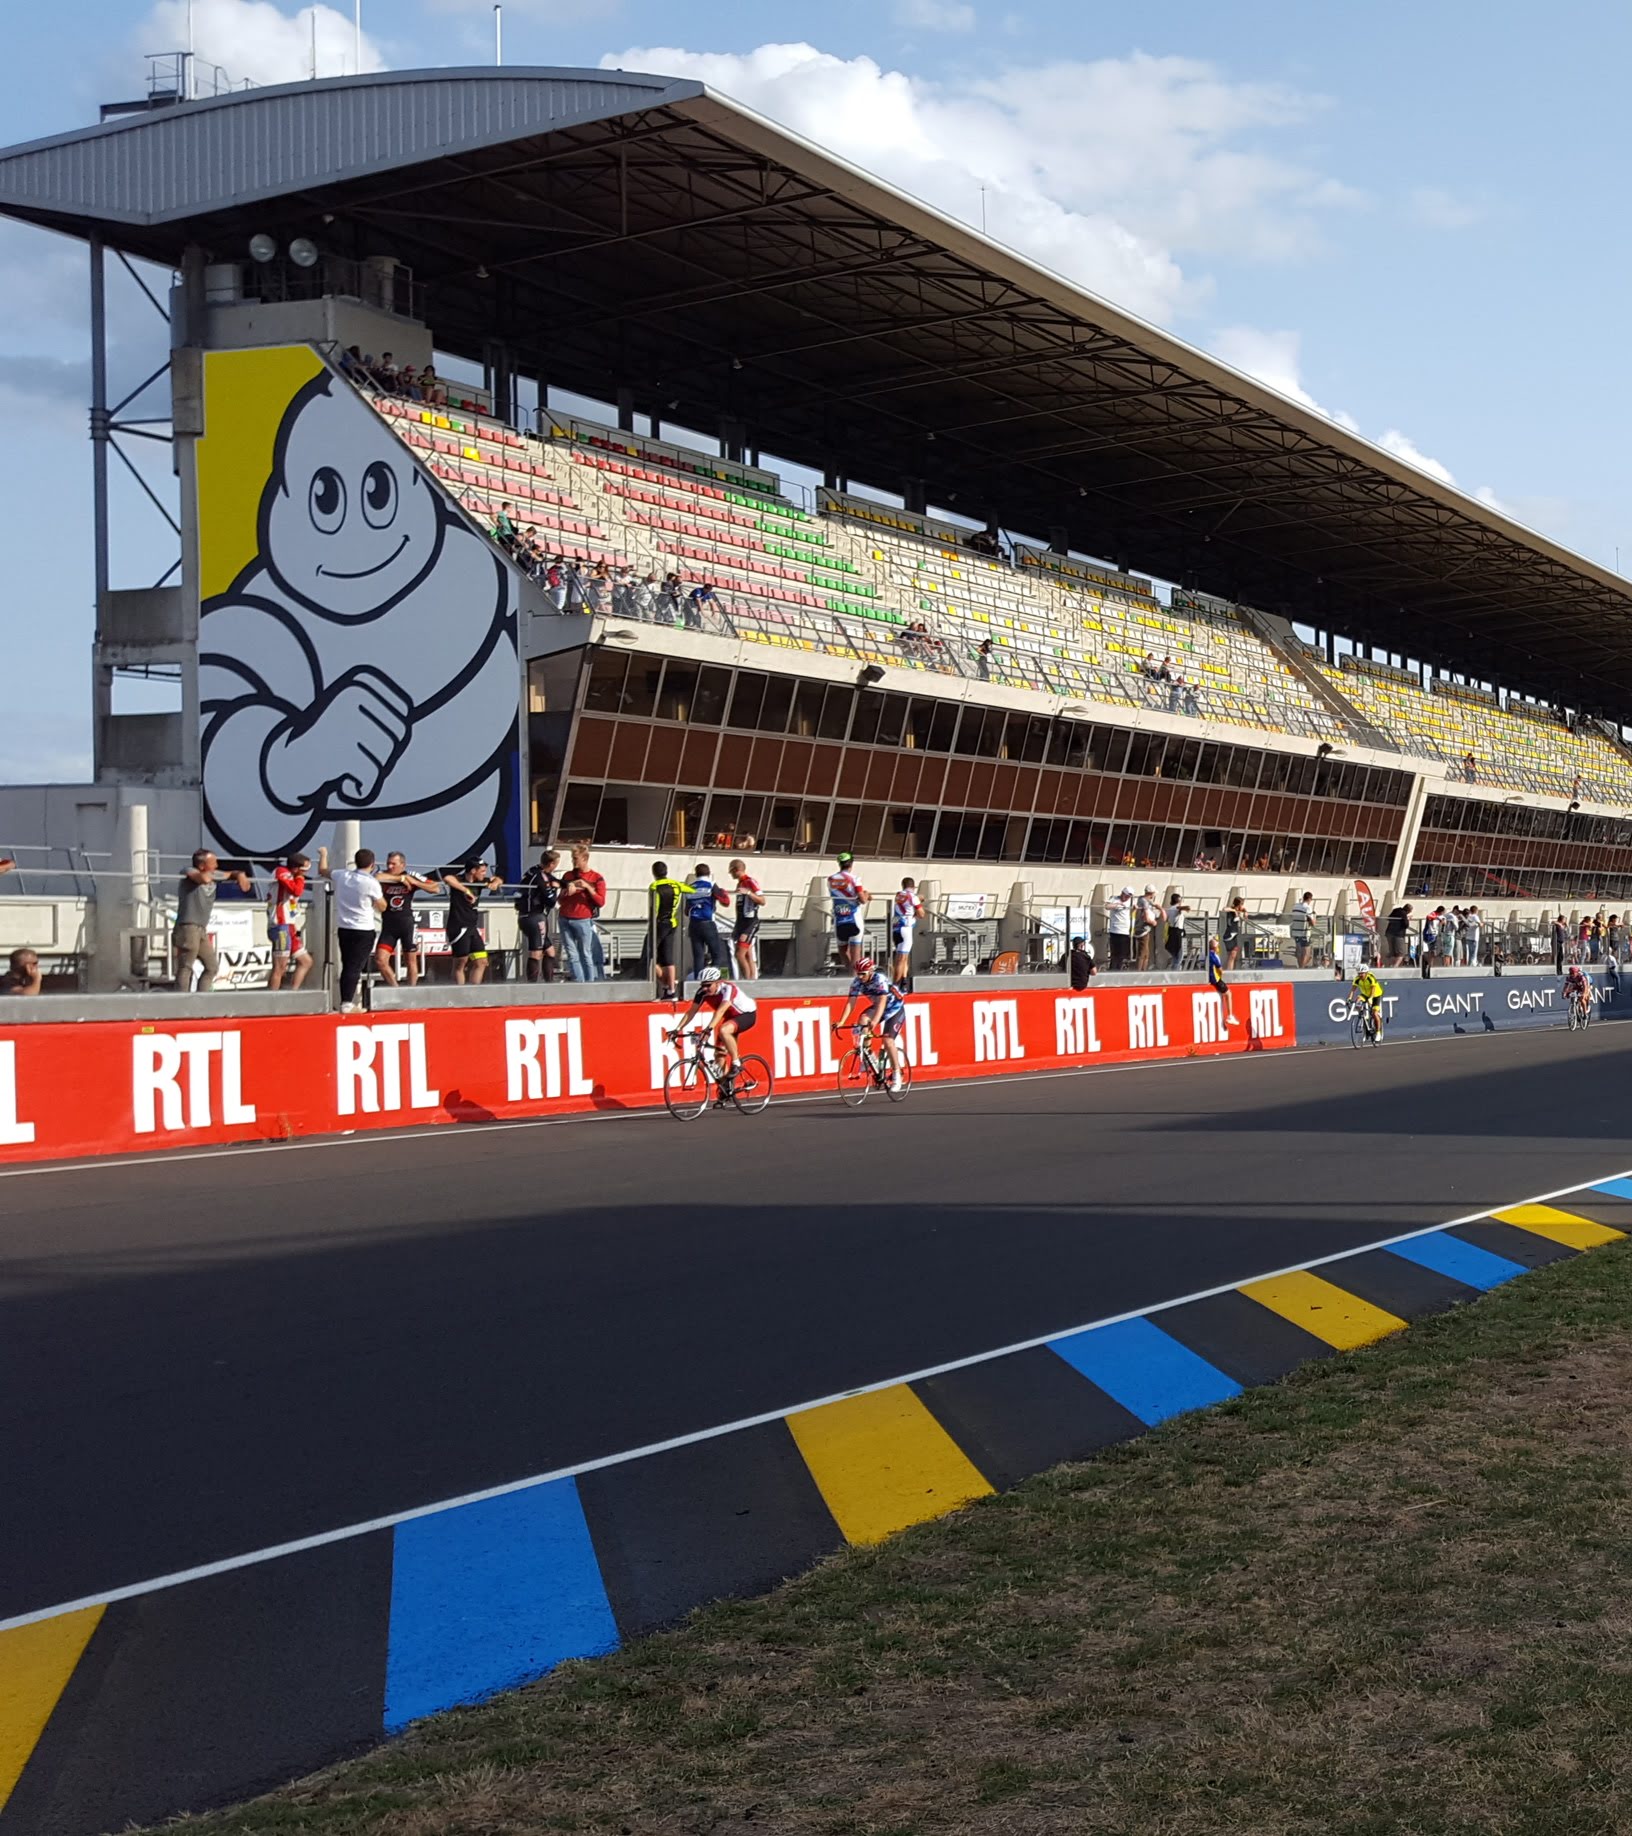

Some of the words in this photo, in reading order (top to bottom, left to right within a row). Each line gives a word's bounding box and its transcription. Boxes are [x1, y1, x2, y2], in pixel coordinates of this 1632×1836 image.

[1055, 996, 1101, 1055] RTL
[1127, 993, 1169, 1049] RTL
[1192, 991, 1229, 1044] RTL
[1249, 989, 1284, 1038] RTL
[1426, 992, 1484, 1016] GANT
[1507, 989, 1556, 1010] GANT
[505, 1016, 594, 1101] RTL
[772, 1006, 839, 1078] RTL
[973, 999, 1025, 1062] RTL
[133, 1030, 256, 1133] RTL
[336, 1022, 440, 1115] RTL
